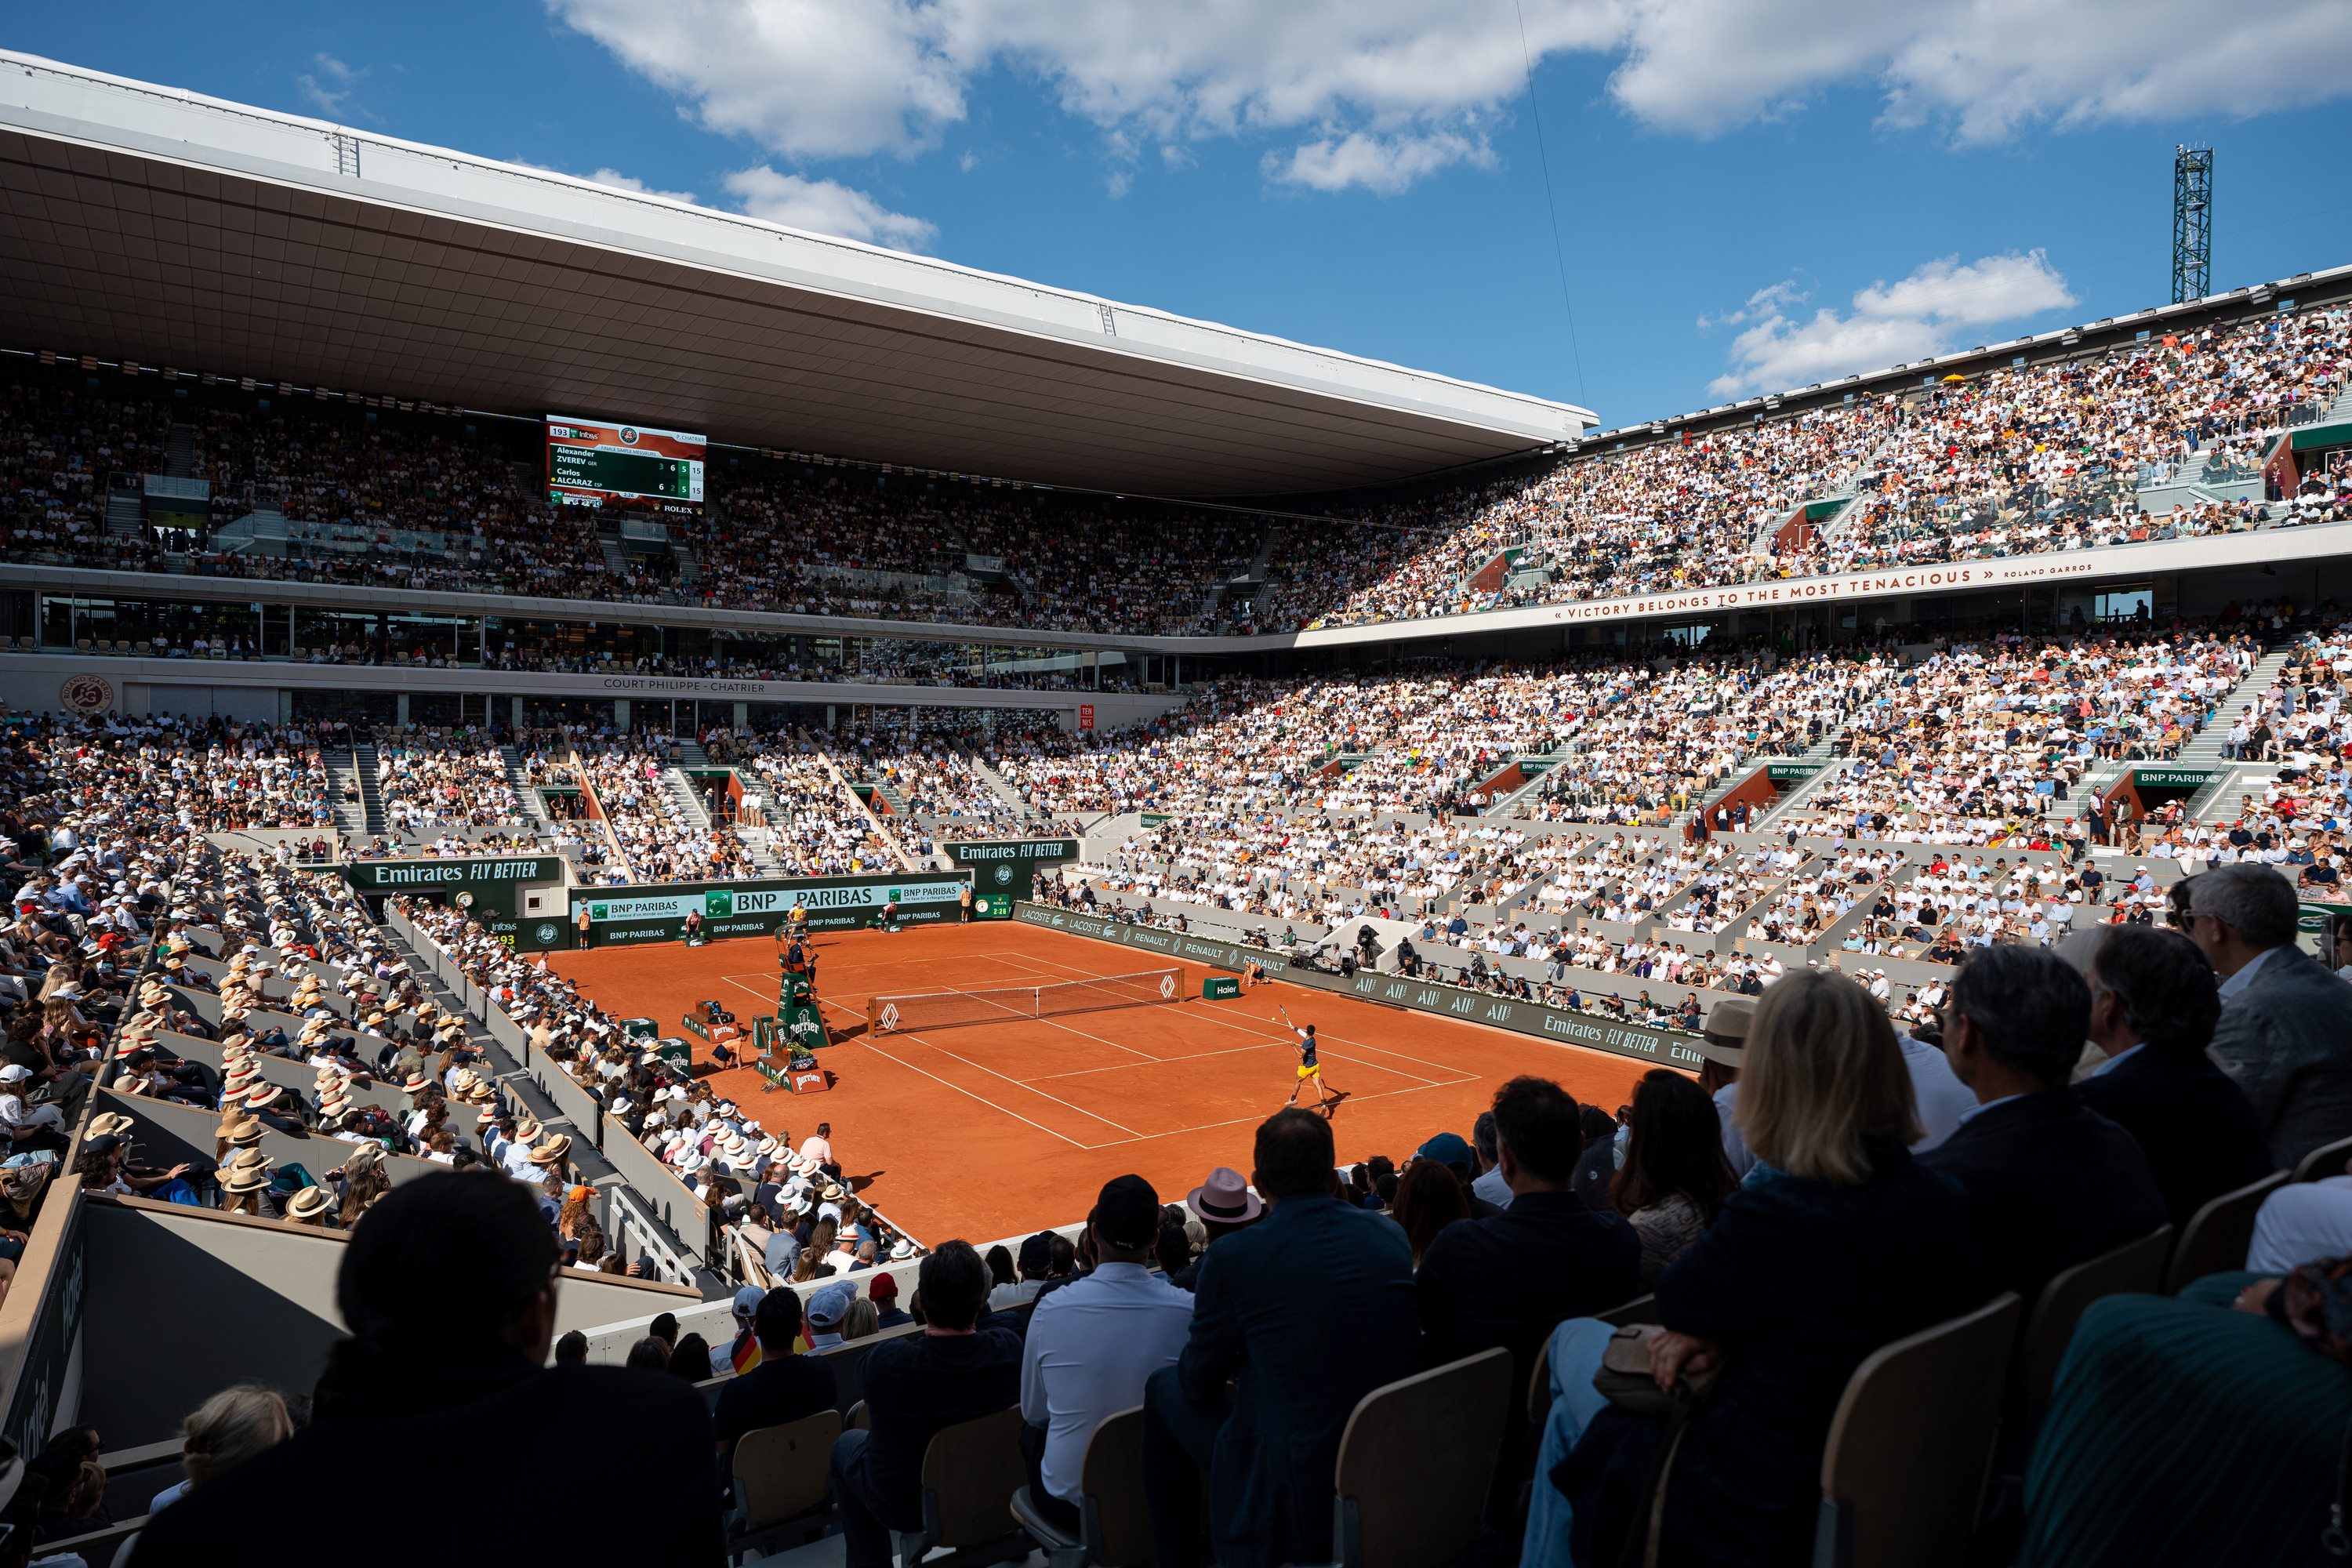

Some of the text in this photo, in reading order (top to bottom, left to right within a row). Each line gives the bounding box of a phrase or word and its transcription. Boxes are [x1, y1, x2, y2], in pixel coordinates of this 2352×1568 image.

[579, 431, 598, 440] Infosys
[557, 447, 594, 457] Alexander
[557, 456, 586, 465] ZVEREV
[557, 468, 580, 477] Carlos
[557, 477, 592, 486] ALCARAZ
[664, 505, 692, 514] ROLEX
[2004, 564, 2092, 578] ROLAND GARROS
[1568, 604, 1631, 619] VICTORY
[1639, 596, 1709, 612] BELONGS
[1718, 593, 1737, 605] TO
[1747, 590, 1780, 602] THE
[1790, 583, 1841, 597] MOST
[1849, 570, 1971, 593] TENACIOUS
[64, 677, 111, 700] ROLAND GARROS
[604, 679, 645, 688] COURT
[649, 681, 700, 691] PHILIPPE
[710, 683, 765, 692] CHATRIER
[2141, 773, 2222, 783] BNP PARIBAS
[960, 843, 1063, 859] Emirates FLY BETTER
[375, 862, 537, 884] Emirates FLY BETTER
[904, 887, 956, 897] BNP PARIBAS
[738, 888, 872, 911] BNP PARIBAS
[612, 901, 678, 913] BNP PARIBAS
[826, 916, 855, 925] PARIBAS
[913, 911, 941, 920] PARIBAS
[1022, 909, 1051, 923] LACOSTE
[492, 922, 517, 931] Infosys
[731, 923, 764, 931] PARIBAS
[1069, 919, 1102, 935] LACOSTE
[495, 935, 515, 945] 193
[630, 929, 665, 938] PARIBAS
[1134, 932, 1169, 947] RENAULT
[1185, 943, 1224, 959] RENAULT
[1243, 955, 1285, 972] RENAULT
[1217, 985, 1236, 994] Haier
[713, 1025, 735, 1040] Perrier
[789, 1019, 819, 1036] Perrier
[1544, 1014, 1658, 1054] Emirates FLY BETTER
[796, 1073, 821, 1091] Perrier
[62, 1242, 84, 1353] Haier
